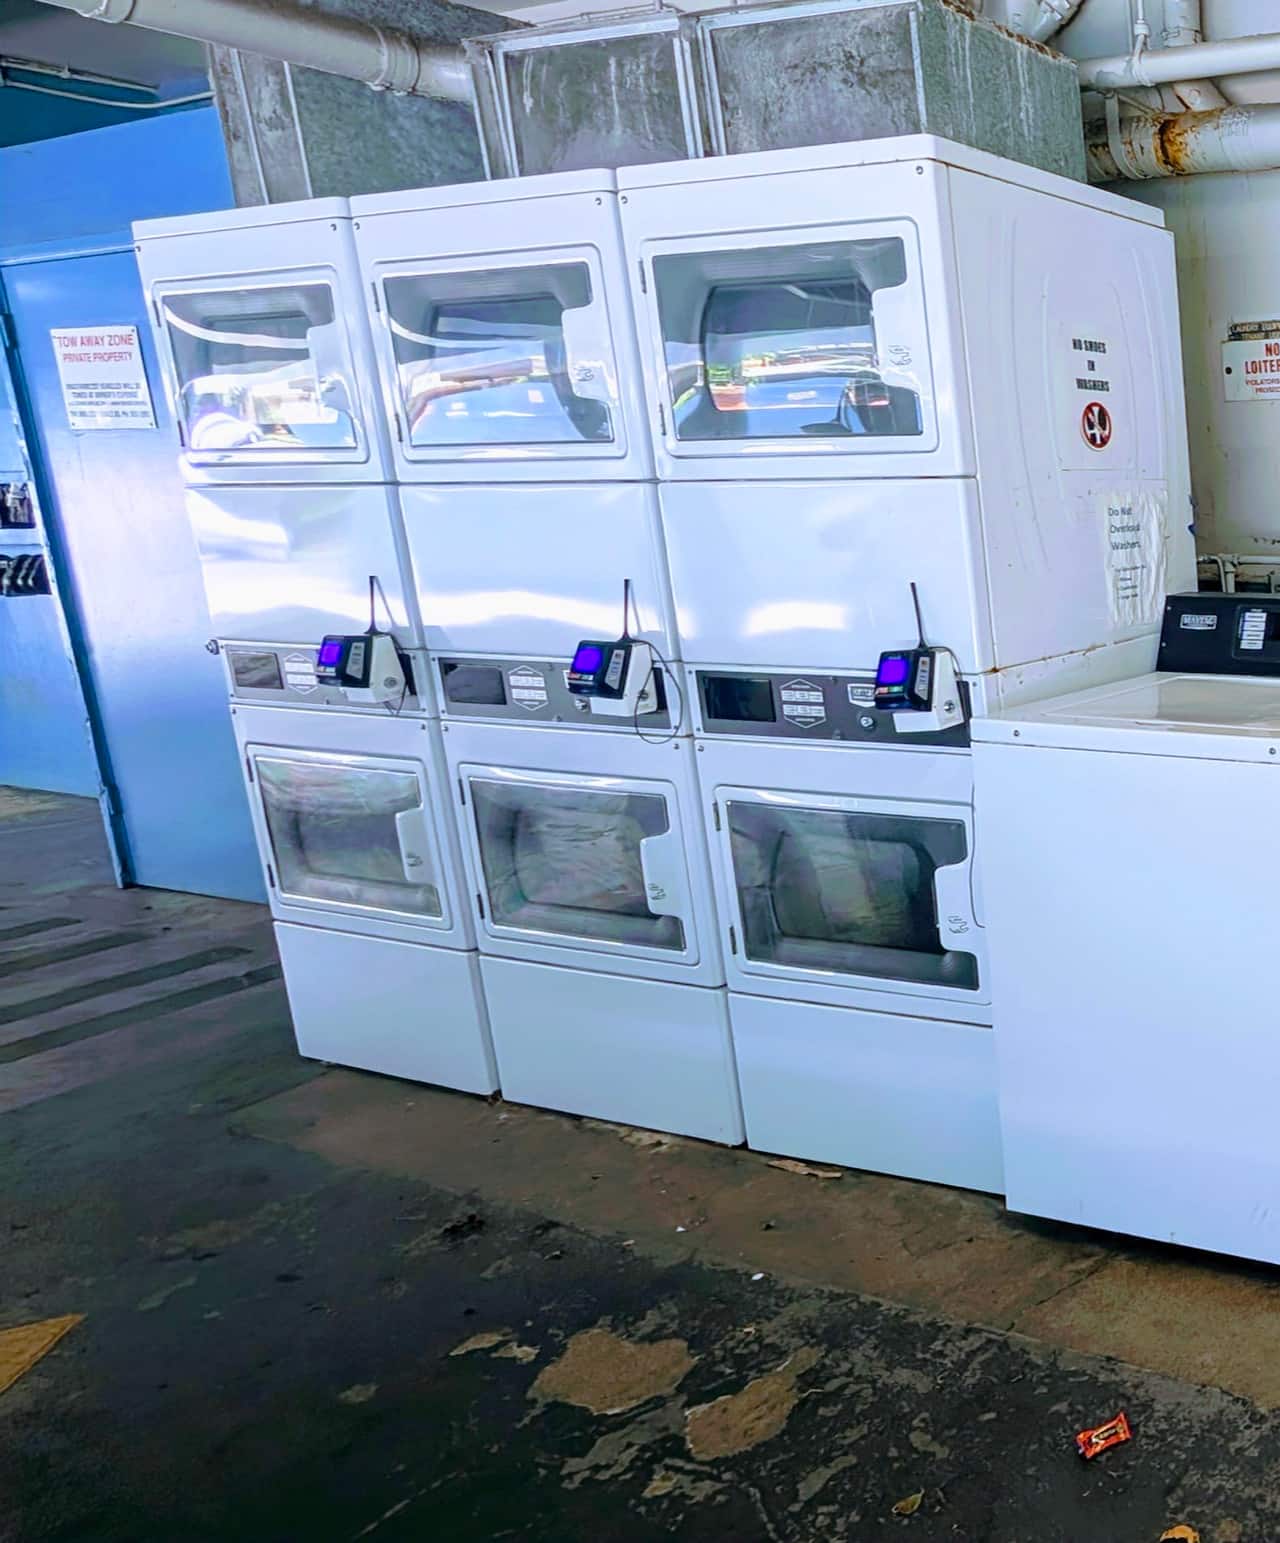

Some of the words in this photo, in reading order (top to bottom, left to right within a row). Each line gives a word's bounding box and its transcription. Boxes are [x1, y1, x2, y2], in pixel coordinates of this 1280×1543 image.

[57, 335, 77, 348] TOW
[80, 335, 104, 346] AWAY
[106, 333, 135, 346] ZONE
[1072, 338, 1083, 351] NO
[1084, 340, 1106, 354] SHOES
[63, 352, 92, 362] PRIVATE
[93, 351, 132, 362] PROPERTY
[1265, 342, 1280, 357] NO
[1087, 360, 1095, 371] IN
[1076, 378, 1109, 392] WASHERS
